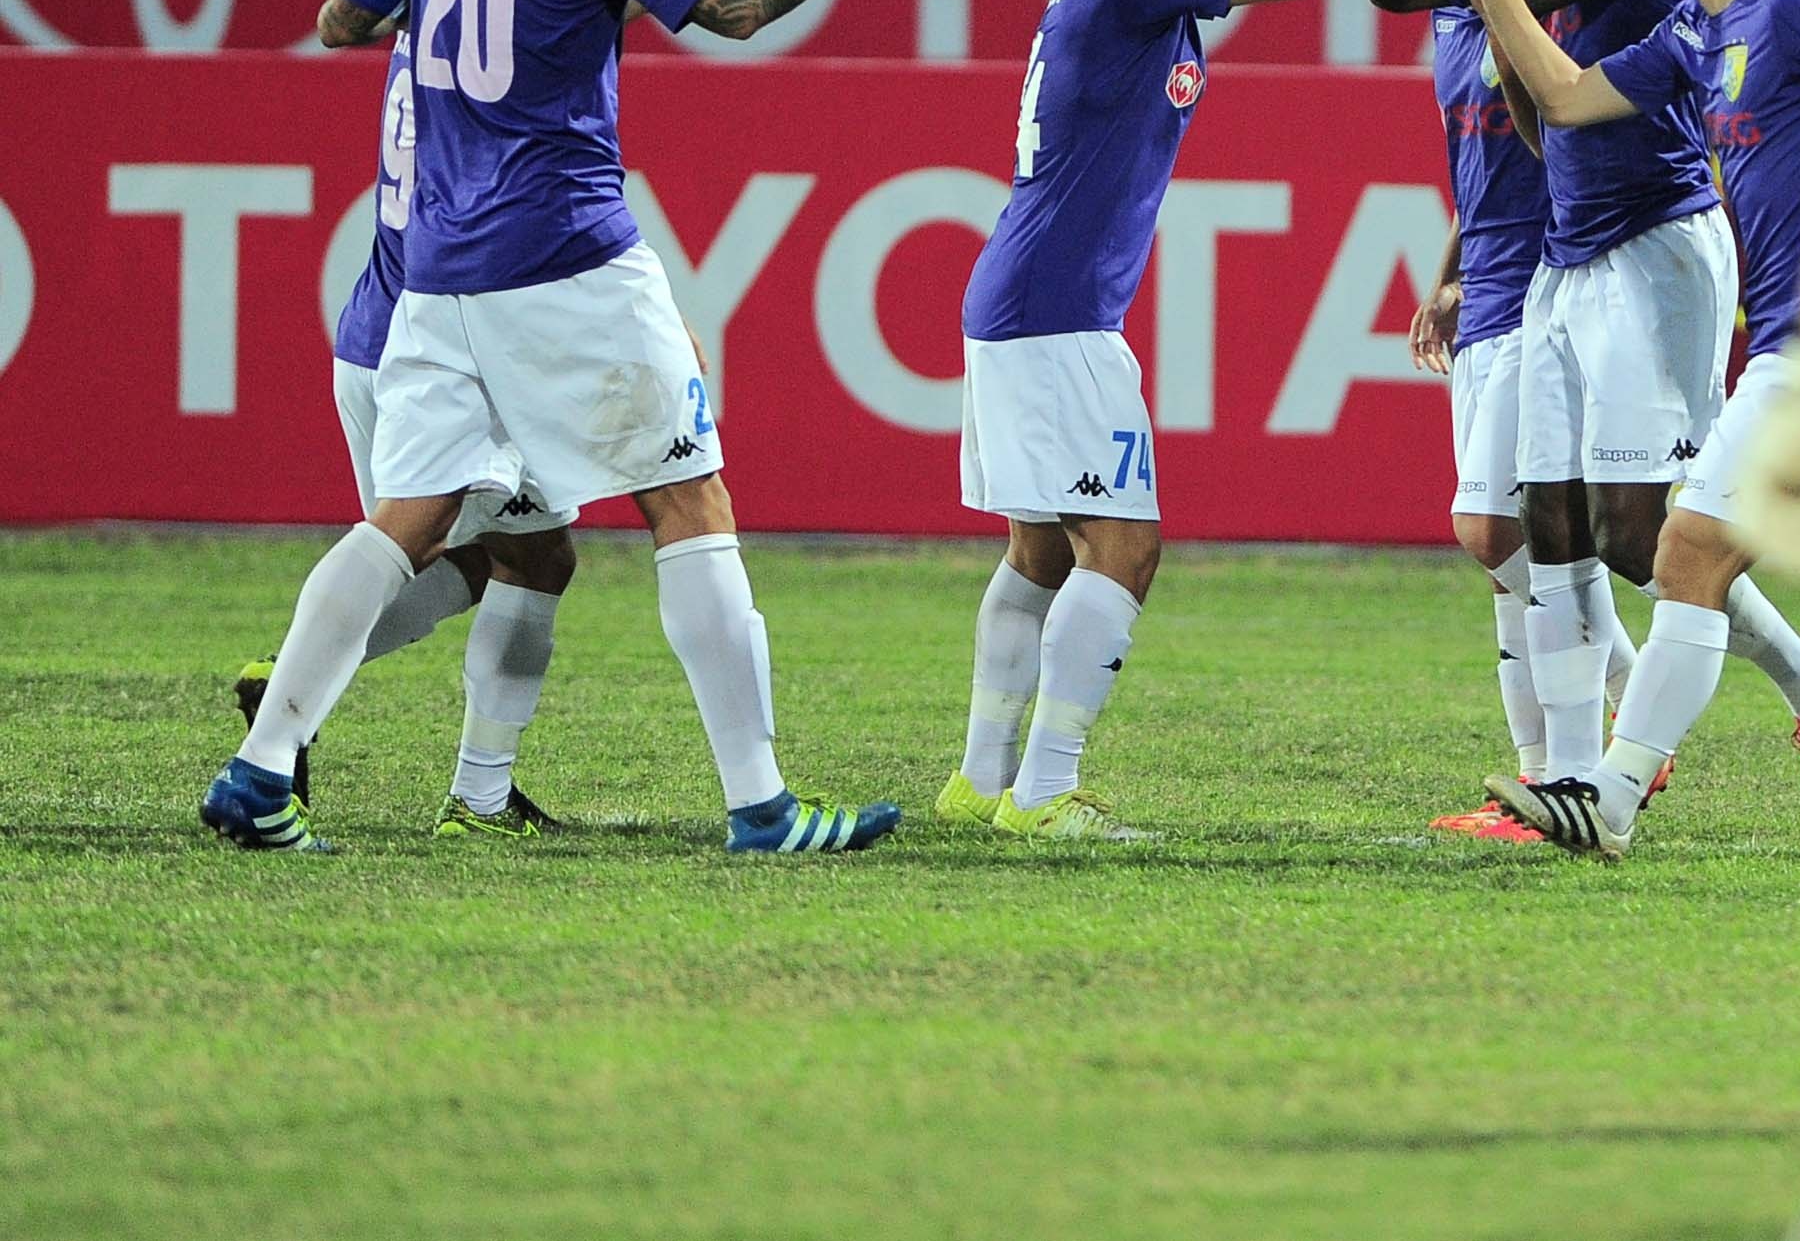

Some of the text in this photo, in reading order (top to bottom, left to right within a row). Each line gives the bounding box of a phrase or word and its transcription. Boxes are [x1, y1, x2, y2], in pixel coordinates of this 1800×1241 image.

[106, 163, 1458, 435] TYOTA
[1111, 430, 1153, 492] 74
[1591, 447, 1650, 462] Kappa
